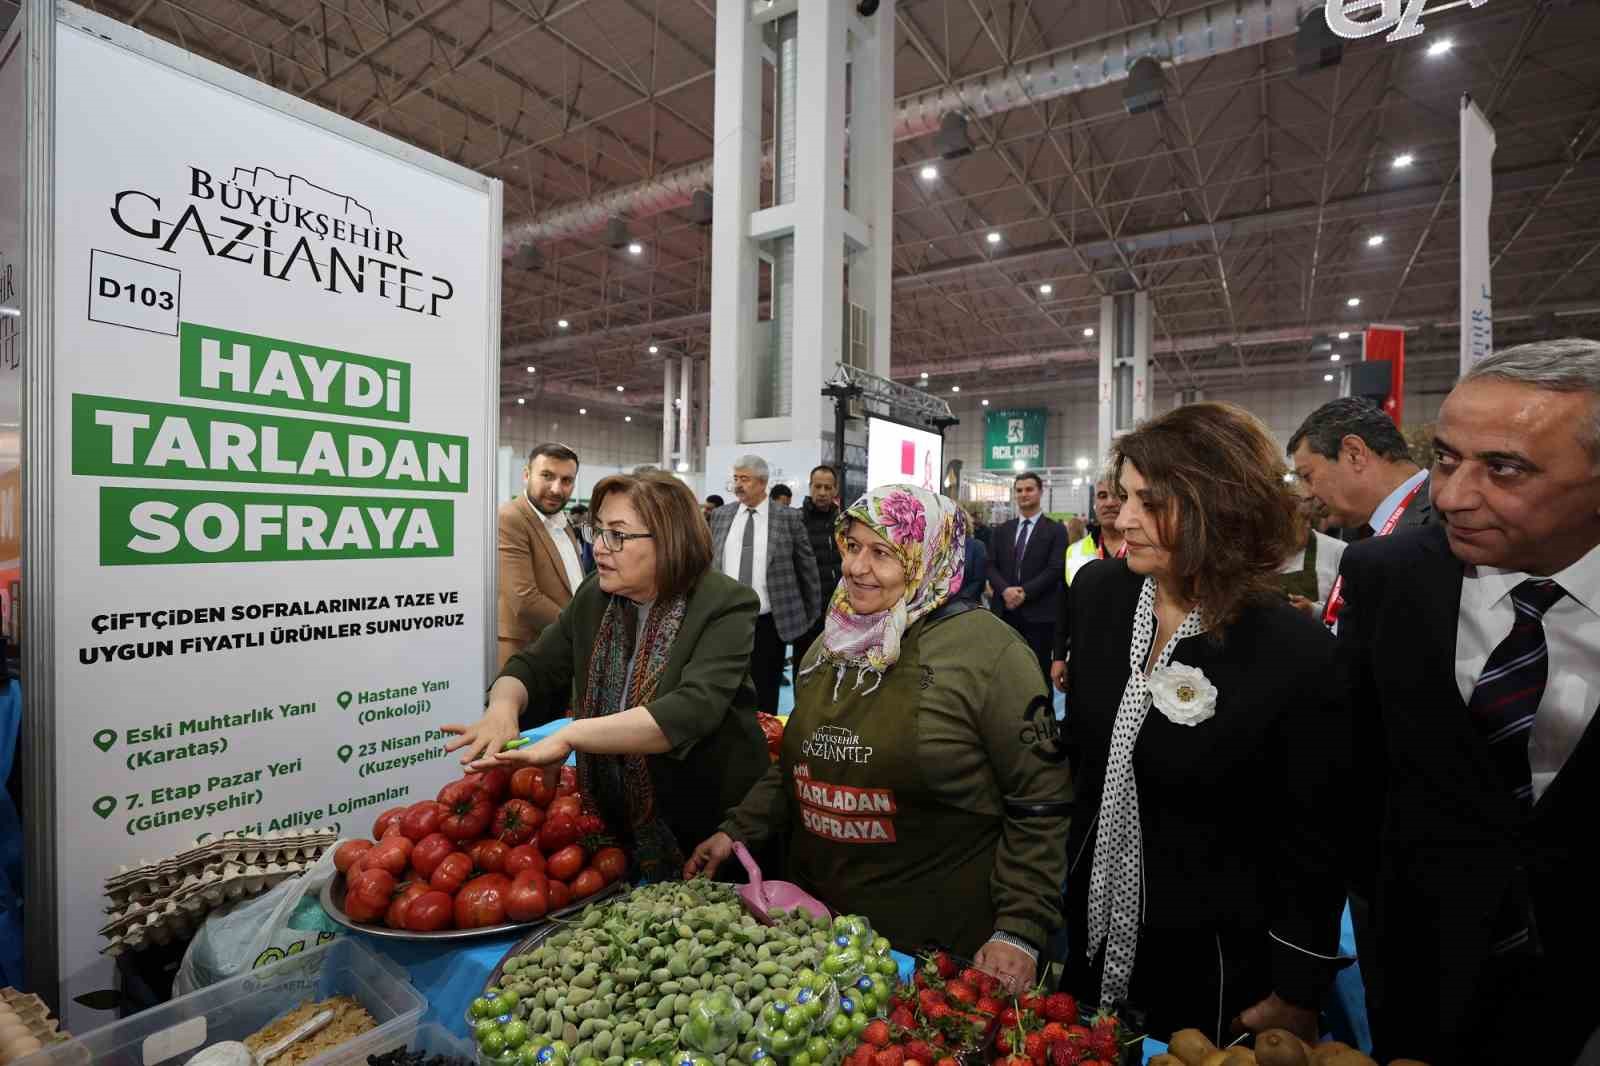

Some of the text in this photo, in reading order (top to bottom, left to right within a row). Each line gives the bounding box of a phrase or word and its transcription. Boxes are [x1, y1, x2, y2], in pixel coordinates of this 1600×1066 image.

[110, 190, 454, 318] GAZİANTEP
[98, 277, 175, 311] D103
[95, 409, 462, 485] TARLADAN
[126, 500, 440, 554] SOFRAYA
[231, 596, 390, 621] SOFRALARINIZA
[395, 592, 435, 608] TAZE
[438, 591, 459, 604] VE
[79, 639, 174, 665] UYGUN
[270, 622, 361, 645] ÜRÜNLER
[366, 613, 465, 637] SUNUYORUZ
[358, 680, 450, 705] Hastane Yanı
[126, 701, 317, 745] Eski Muhtarlık Yanı
[358, 700, 431, 725] (Onkoloji)
[126, 737, 228, 771] (Karataş)
[358, 743, 376, 758] 23
[381, 734, 421, 752] Nisan
[125, 758, 302, 810] 7. Etap Pazar Yeri
[795, 779, 890, 812] TARLADAN
[126, 789, 263, 836] (Güneyşehir)
[268, 807, 323, 832] Adliye
[328, 785, 409, 815] Lojmanları
[803, 808, 889, 840] SOFRAYA
